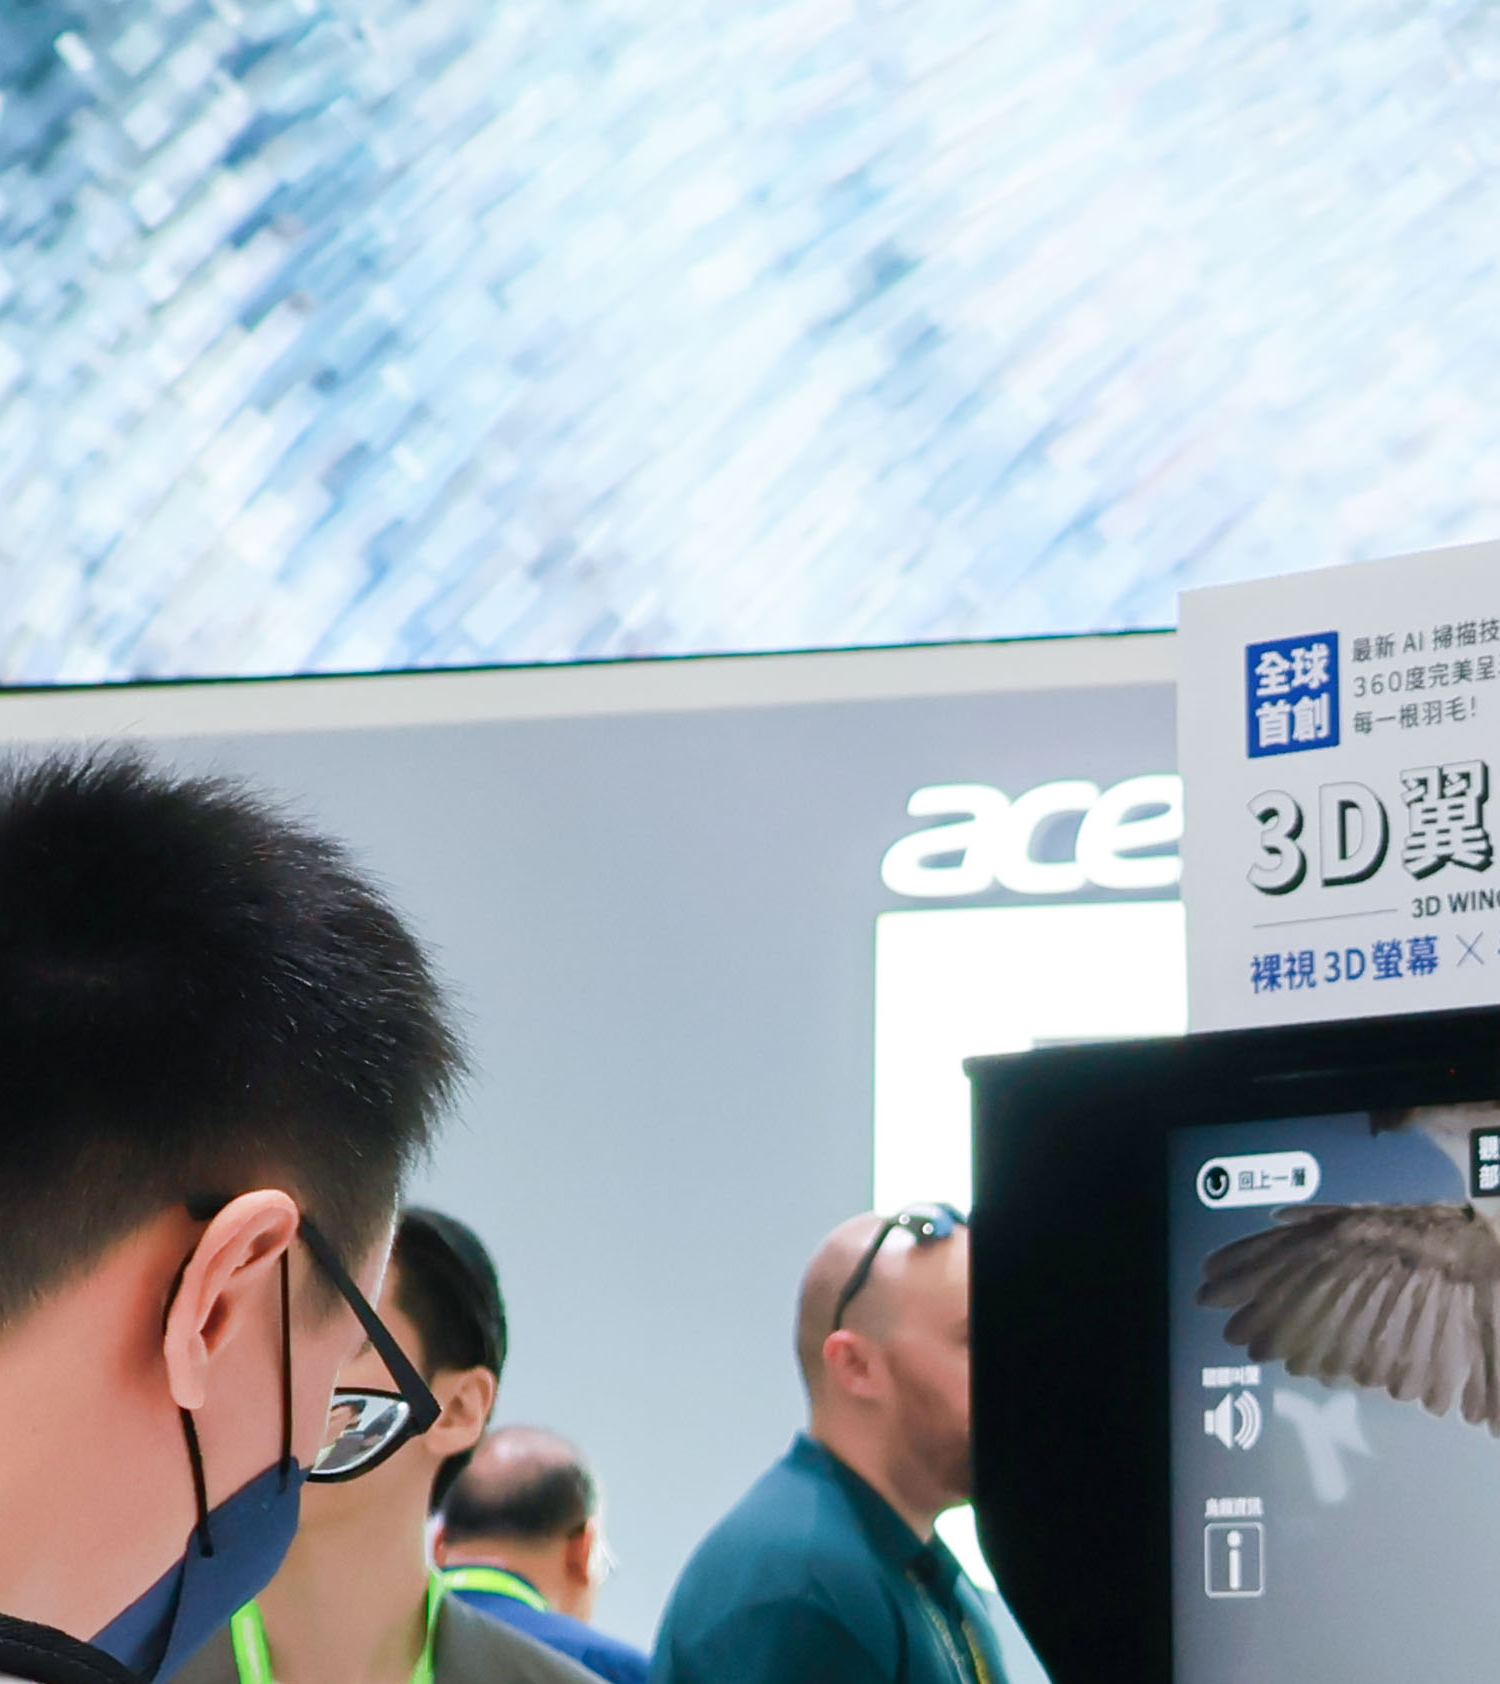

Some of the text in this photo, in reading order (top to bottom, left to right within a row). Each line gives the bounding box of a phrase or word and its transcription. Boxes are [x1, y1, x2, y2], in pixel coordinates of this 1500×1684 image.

[1255, 642, 1330, 697] 全球
[1255, 695, 1330, 748] 首創
[1412, 895, 1441, 919] 3D
